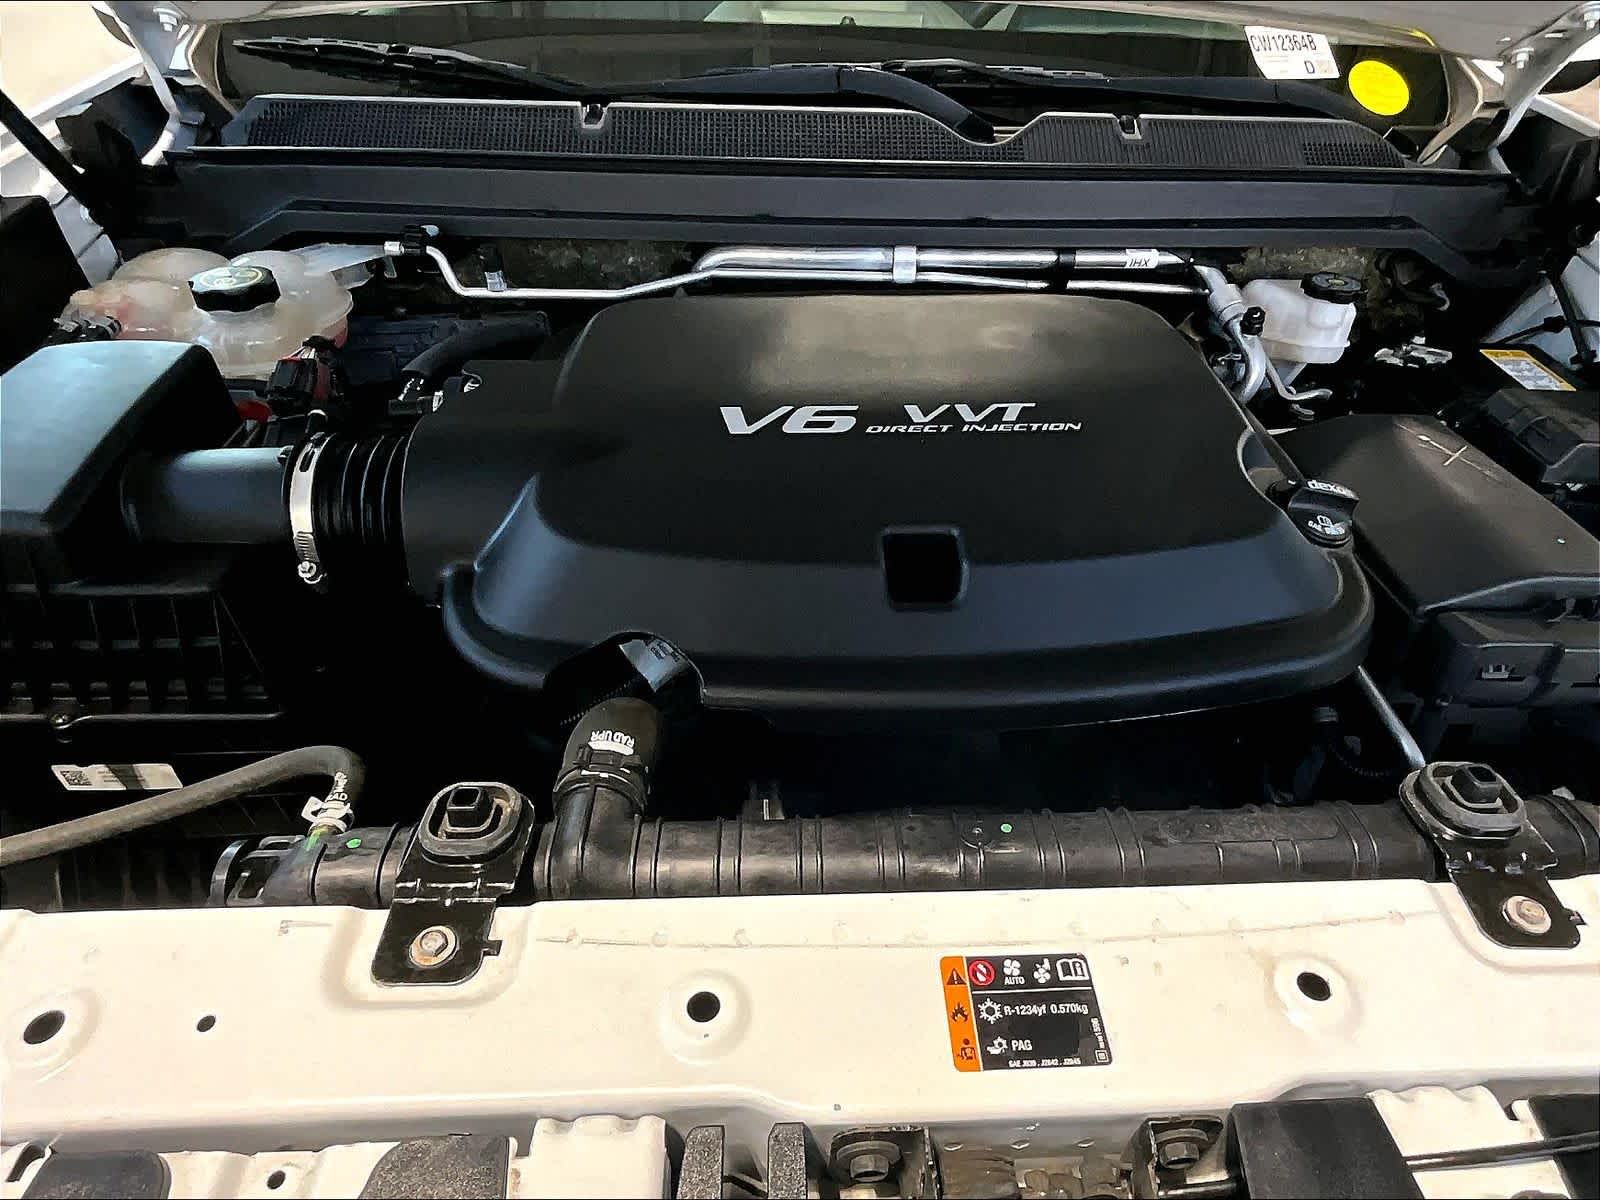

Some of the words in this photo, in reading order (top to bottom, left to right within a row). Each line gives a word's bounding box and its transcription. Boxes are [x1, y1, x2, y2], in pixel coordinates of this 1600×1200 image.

[1249, 34, 1317, 52] CW12364B
[1129, 258, 1151, 267] IHX
[719, 404, 862, 435] V6
[903, 402, 1037, 423] VVT
[865, 424, 953, 433] DIRECT
[962, 422, 1082, 432] INJECTION
[612, 731, 635, 748] RAD
[1004, 976, 1025, 985] AUTO
[1004, 1003, 1047, 1016] R-1234yf
[1050, 1002, 1089, 1014] 0.570kg
[1011, 1040, 1033, 1051] PAG
